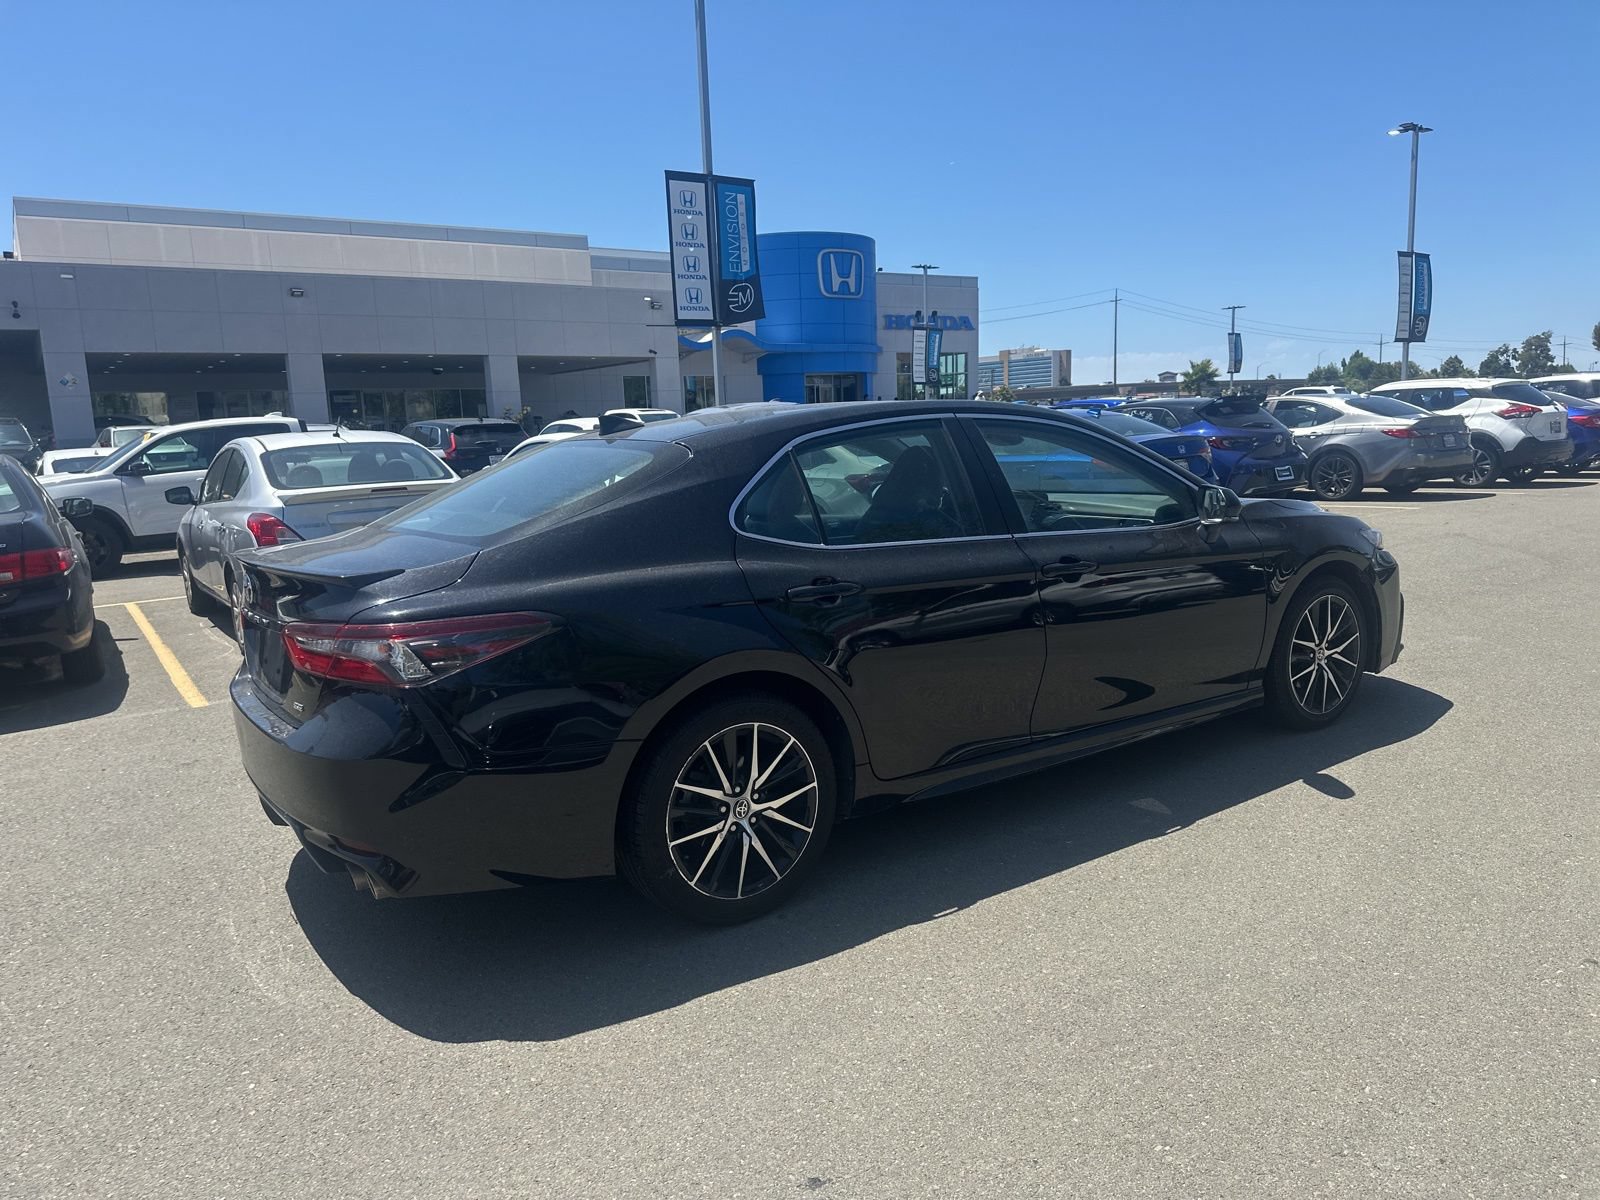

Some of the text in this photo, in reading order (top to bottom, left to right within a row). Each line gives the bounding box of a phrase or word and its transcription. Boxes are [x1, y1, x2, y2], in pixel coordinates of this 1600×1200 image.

[673, 208, 703, 216] HONDA
[725, 191, 741, 273] ENVISION
[739, 200, 748, 266] MOTORS
[675, 241, 706, 249] HONDA
[677, 273, 708, 281] HONDA
